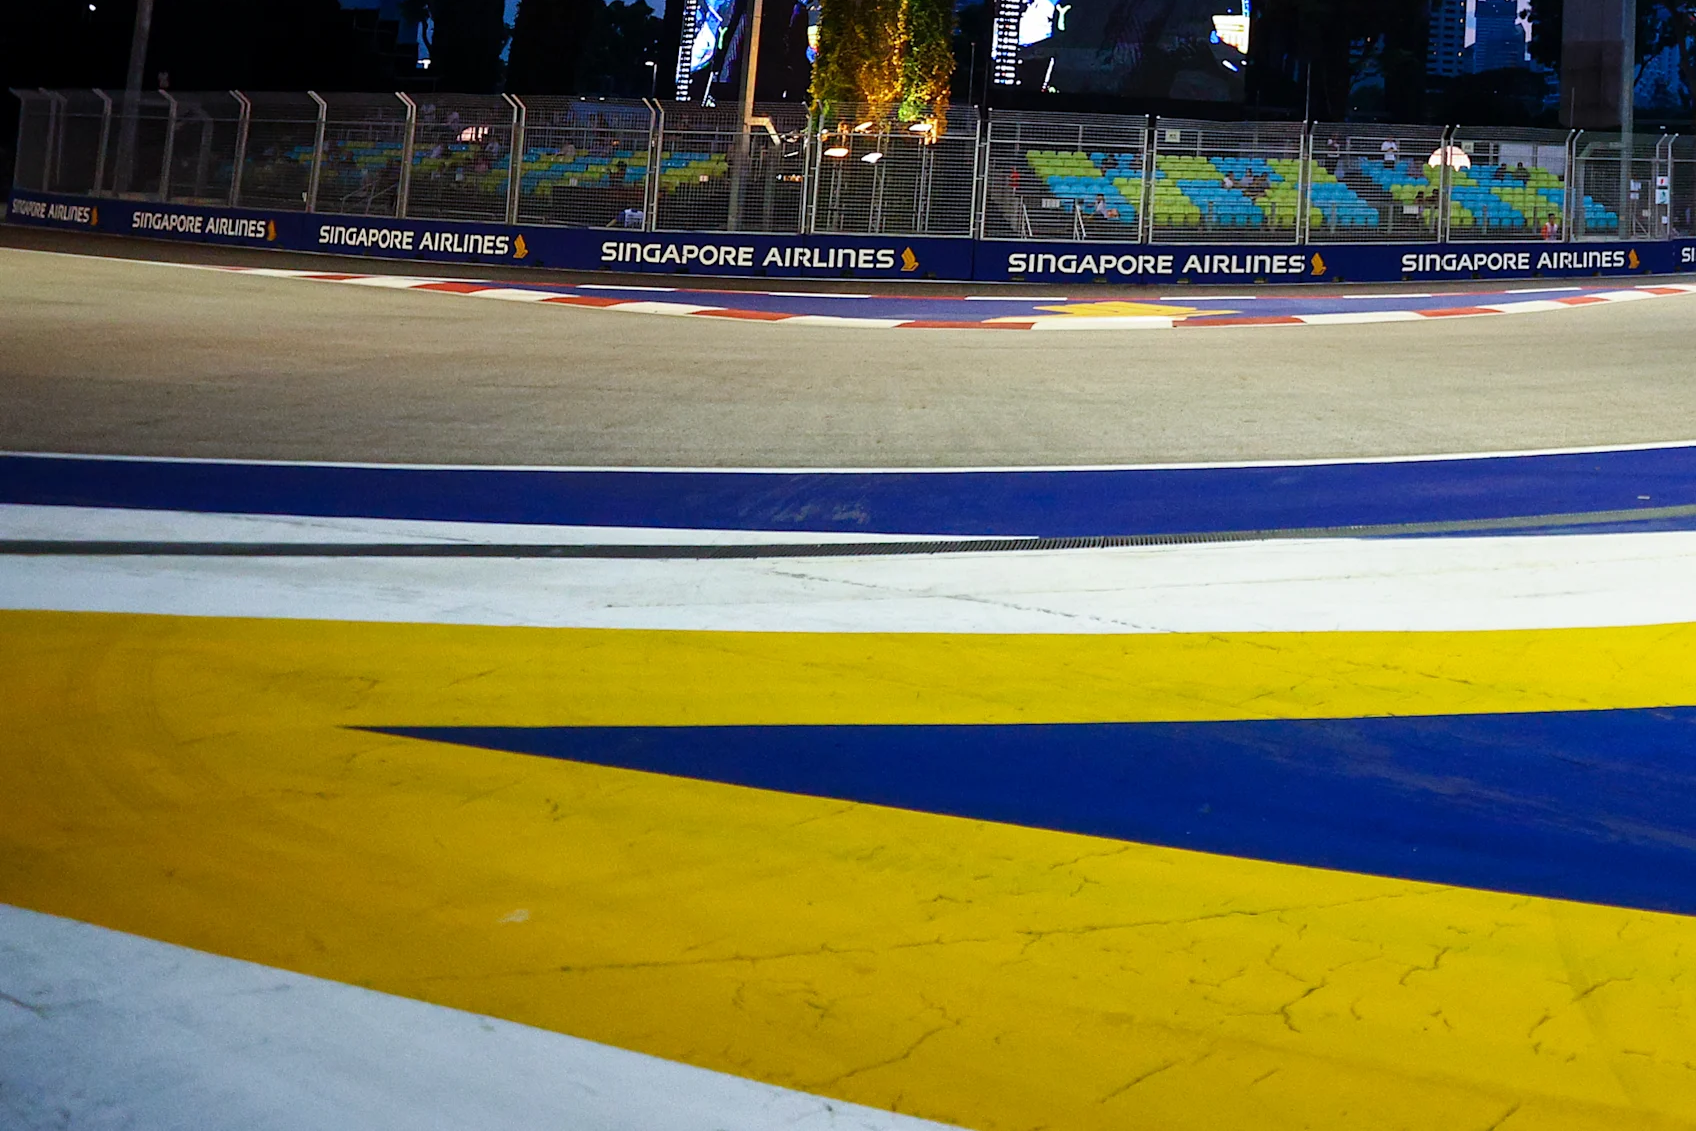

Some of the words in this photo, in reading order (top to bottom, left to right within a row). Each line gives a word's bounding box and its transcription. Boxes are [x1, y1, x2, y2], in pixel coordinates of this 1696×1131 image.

[12, 199, 45, 217] SINGAPORE
[47, 204, 90, 223] AIRLINES
[132, 211, 203, 234] SINGAPORE
[205, 217, 266, 238] AIRLINES
[318, 225, 415, 250] SINGAPORE
[418, 231, 510, 256] AIRLINES
[600, 241, 755, 267] SINGAPORE
[762, 247, 895, 269] AIRLINES
[1007, 253, 1174, 275] SINGAPORE
[1181, 254, 1306, 274] AIRLINES
[1401, 252, 1531, 272] SINGAPORE
[1536, 250, 1625, 269] AIRLINES
